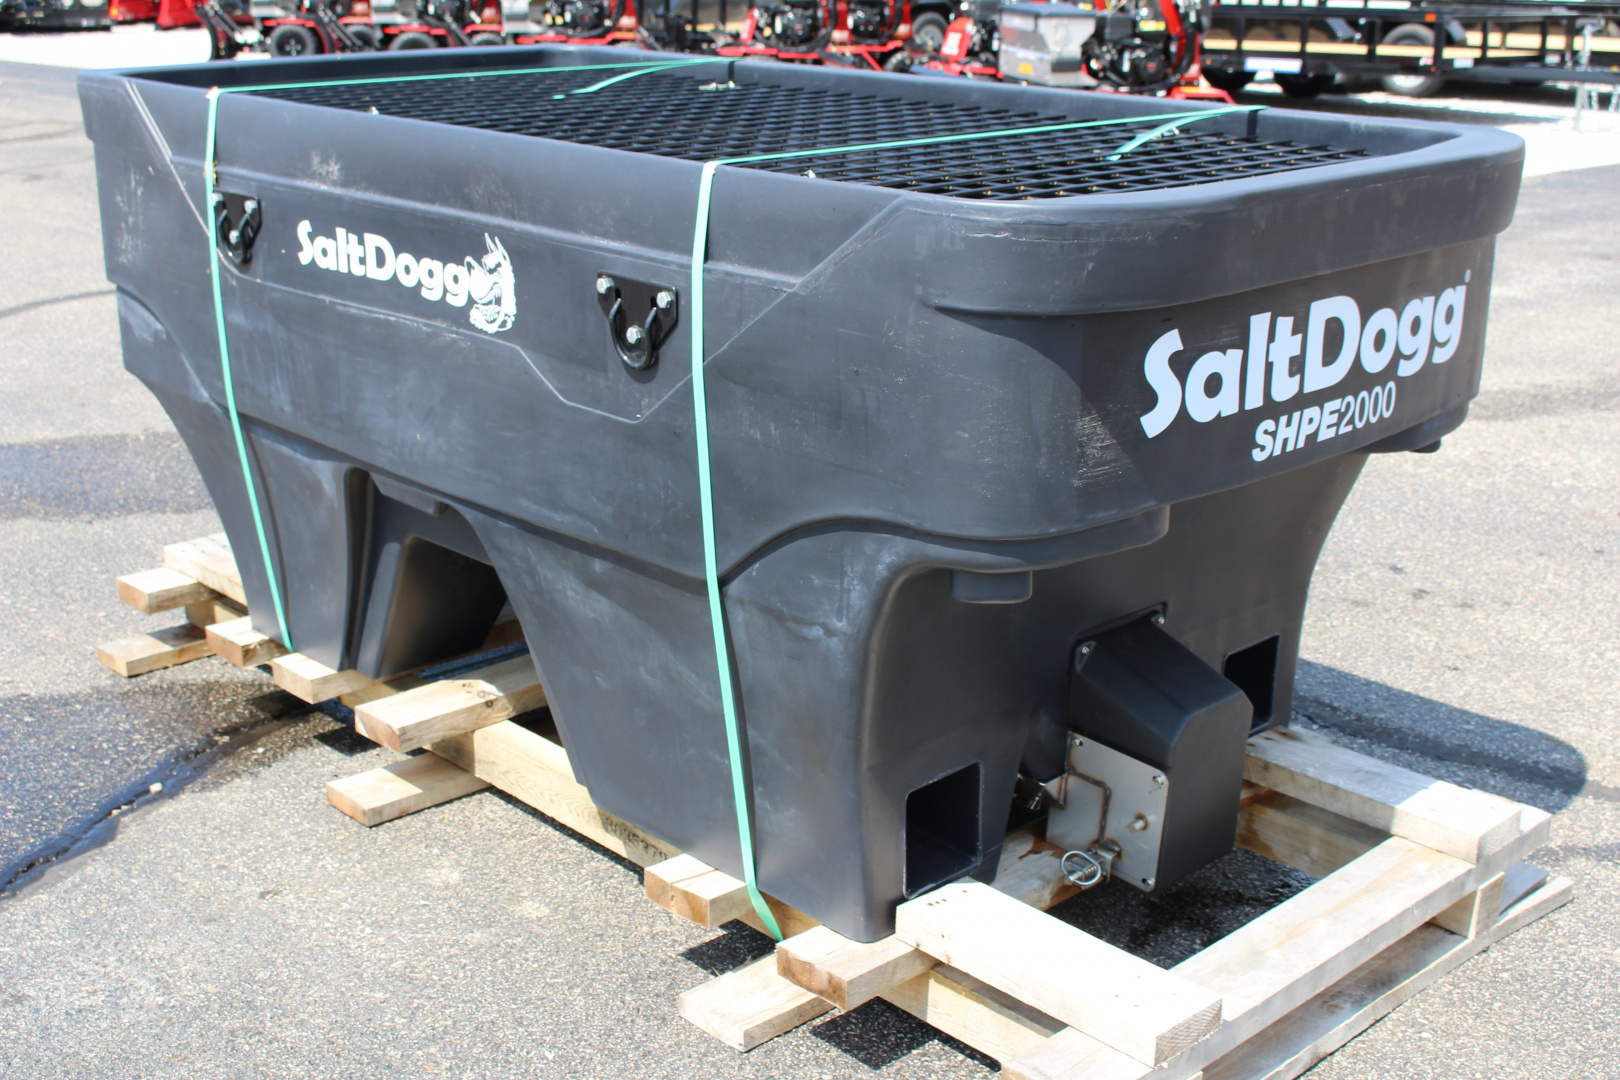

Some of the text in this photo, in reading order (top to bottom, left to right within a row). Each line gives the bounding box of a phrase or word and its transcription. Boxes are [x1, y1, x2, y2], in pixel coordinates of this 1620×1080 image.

[297, 219, 471, 308] SaltDogg
[1139, 284, 1467, 439] SaltDogg
[1251, 380, 1397, 462] SHPE2000
